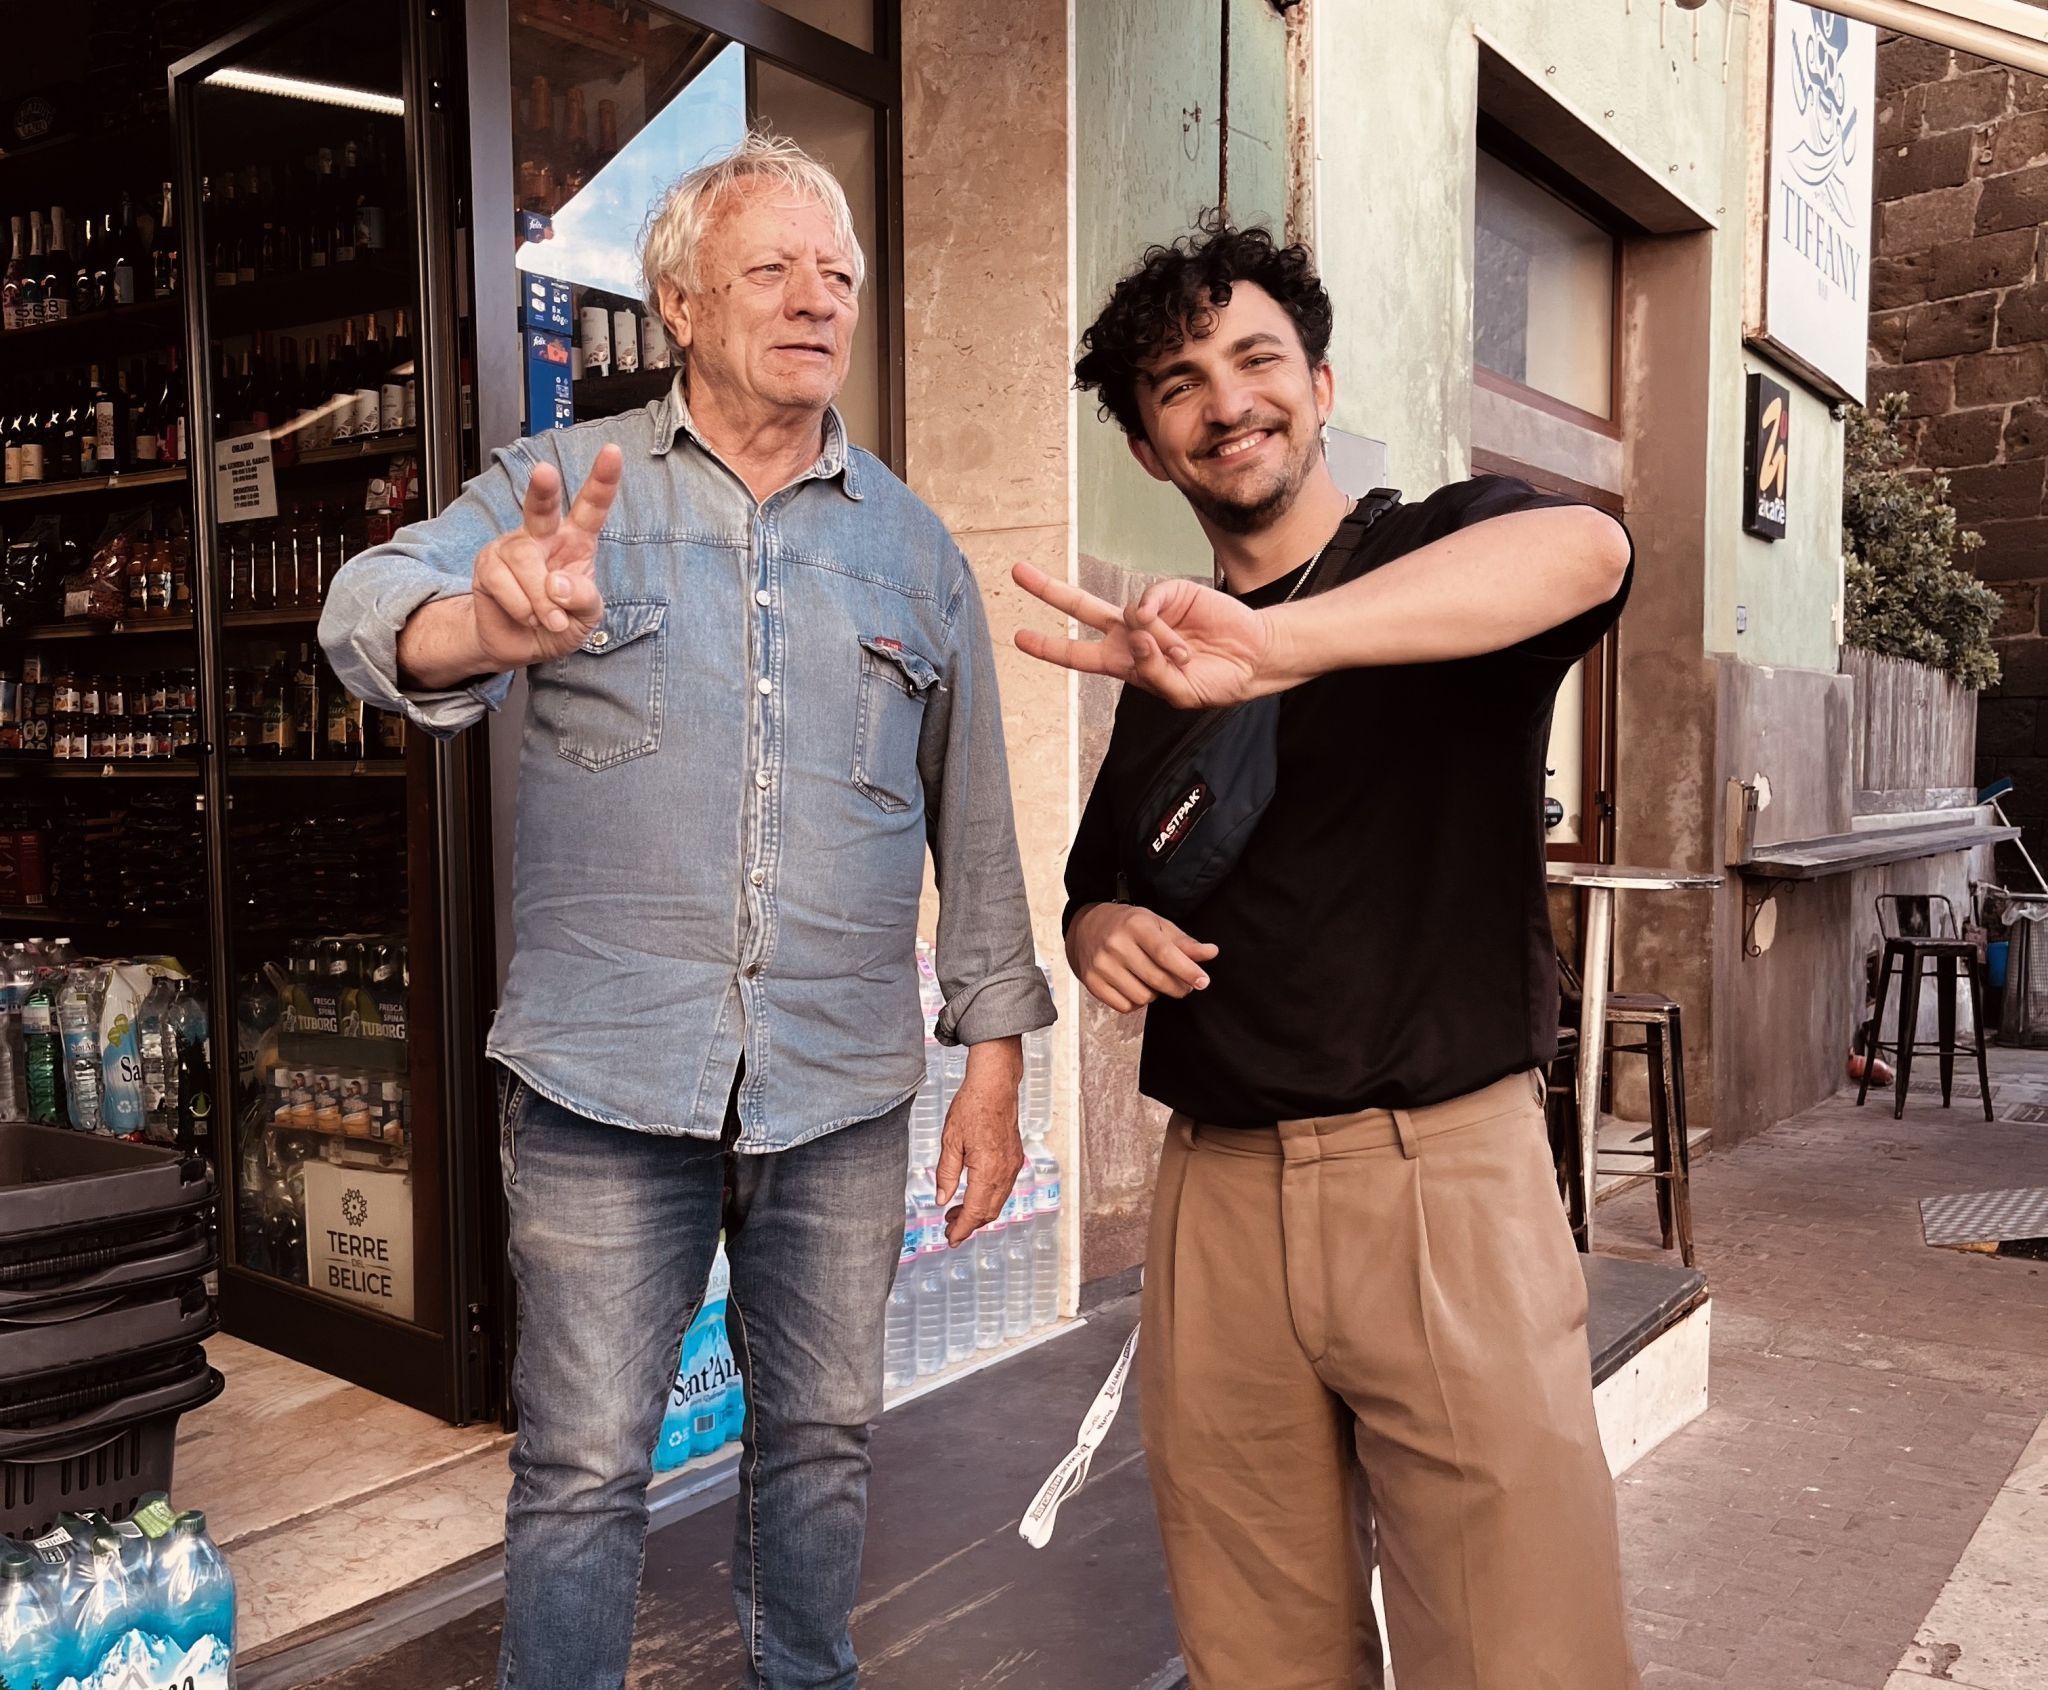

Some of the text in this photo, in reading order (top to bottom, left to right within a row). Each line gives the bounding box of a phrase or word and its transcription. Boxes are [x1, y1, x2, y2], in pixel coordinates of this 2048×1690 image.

[1780, 180, 1861, 302] TIFFANY
[232, 442, 254, 453] ORARIO
[1152, 788, 1200, 853] EASTPAK
[313, 997, 336, 1006] FRESCA
[379, 1003, 403, 1012] FRESCA
[318, 1007, 336, 1016] SPINA
[383, 1013, 405, 1023] SPINA
[297, 1014, 338, 1033] TUBORG
[360, 1020, 406, 1039] TUBORG
[326, 1230, 389, 1262] TERRE
[351, 1259, 366, 1269] DEL
[328, 1265, 393, 1298] BELICE
